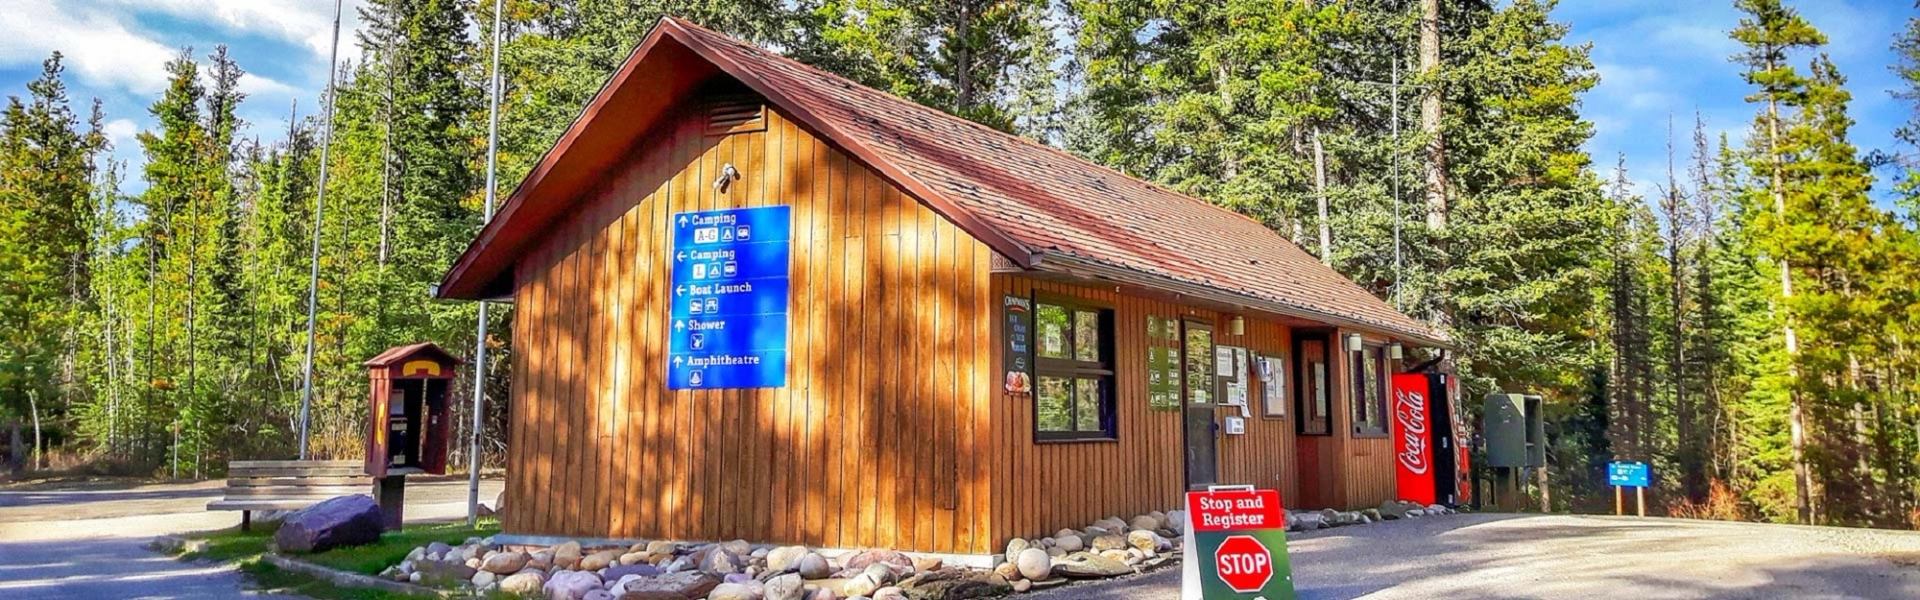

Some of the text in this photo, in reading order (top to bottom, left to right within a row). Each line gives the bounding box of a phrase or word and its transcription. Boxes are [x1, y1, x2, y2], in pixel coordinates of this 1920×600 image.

[692, 214, 736, 226] Camping
[697, 229, 716, 241] A-G
[690, 248, 735, 261] Camping
[689, 282, 752, 295] Boat Launch
[688, 320, 725, 331] Shower
[687, 355, 760, 368] Amphitheatre
[1200, 496, 1264, 513] Stop and
[1202, 512, 1265, 528] Register
[1220, 552, 1267, 575] STOP
